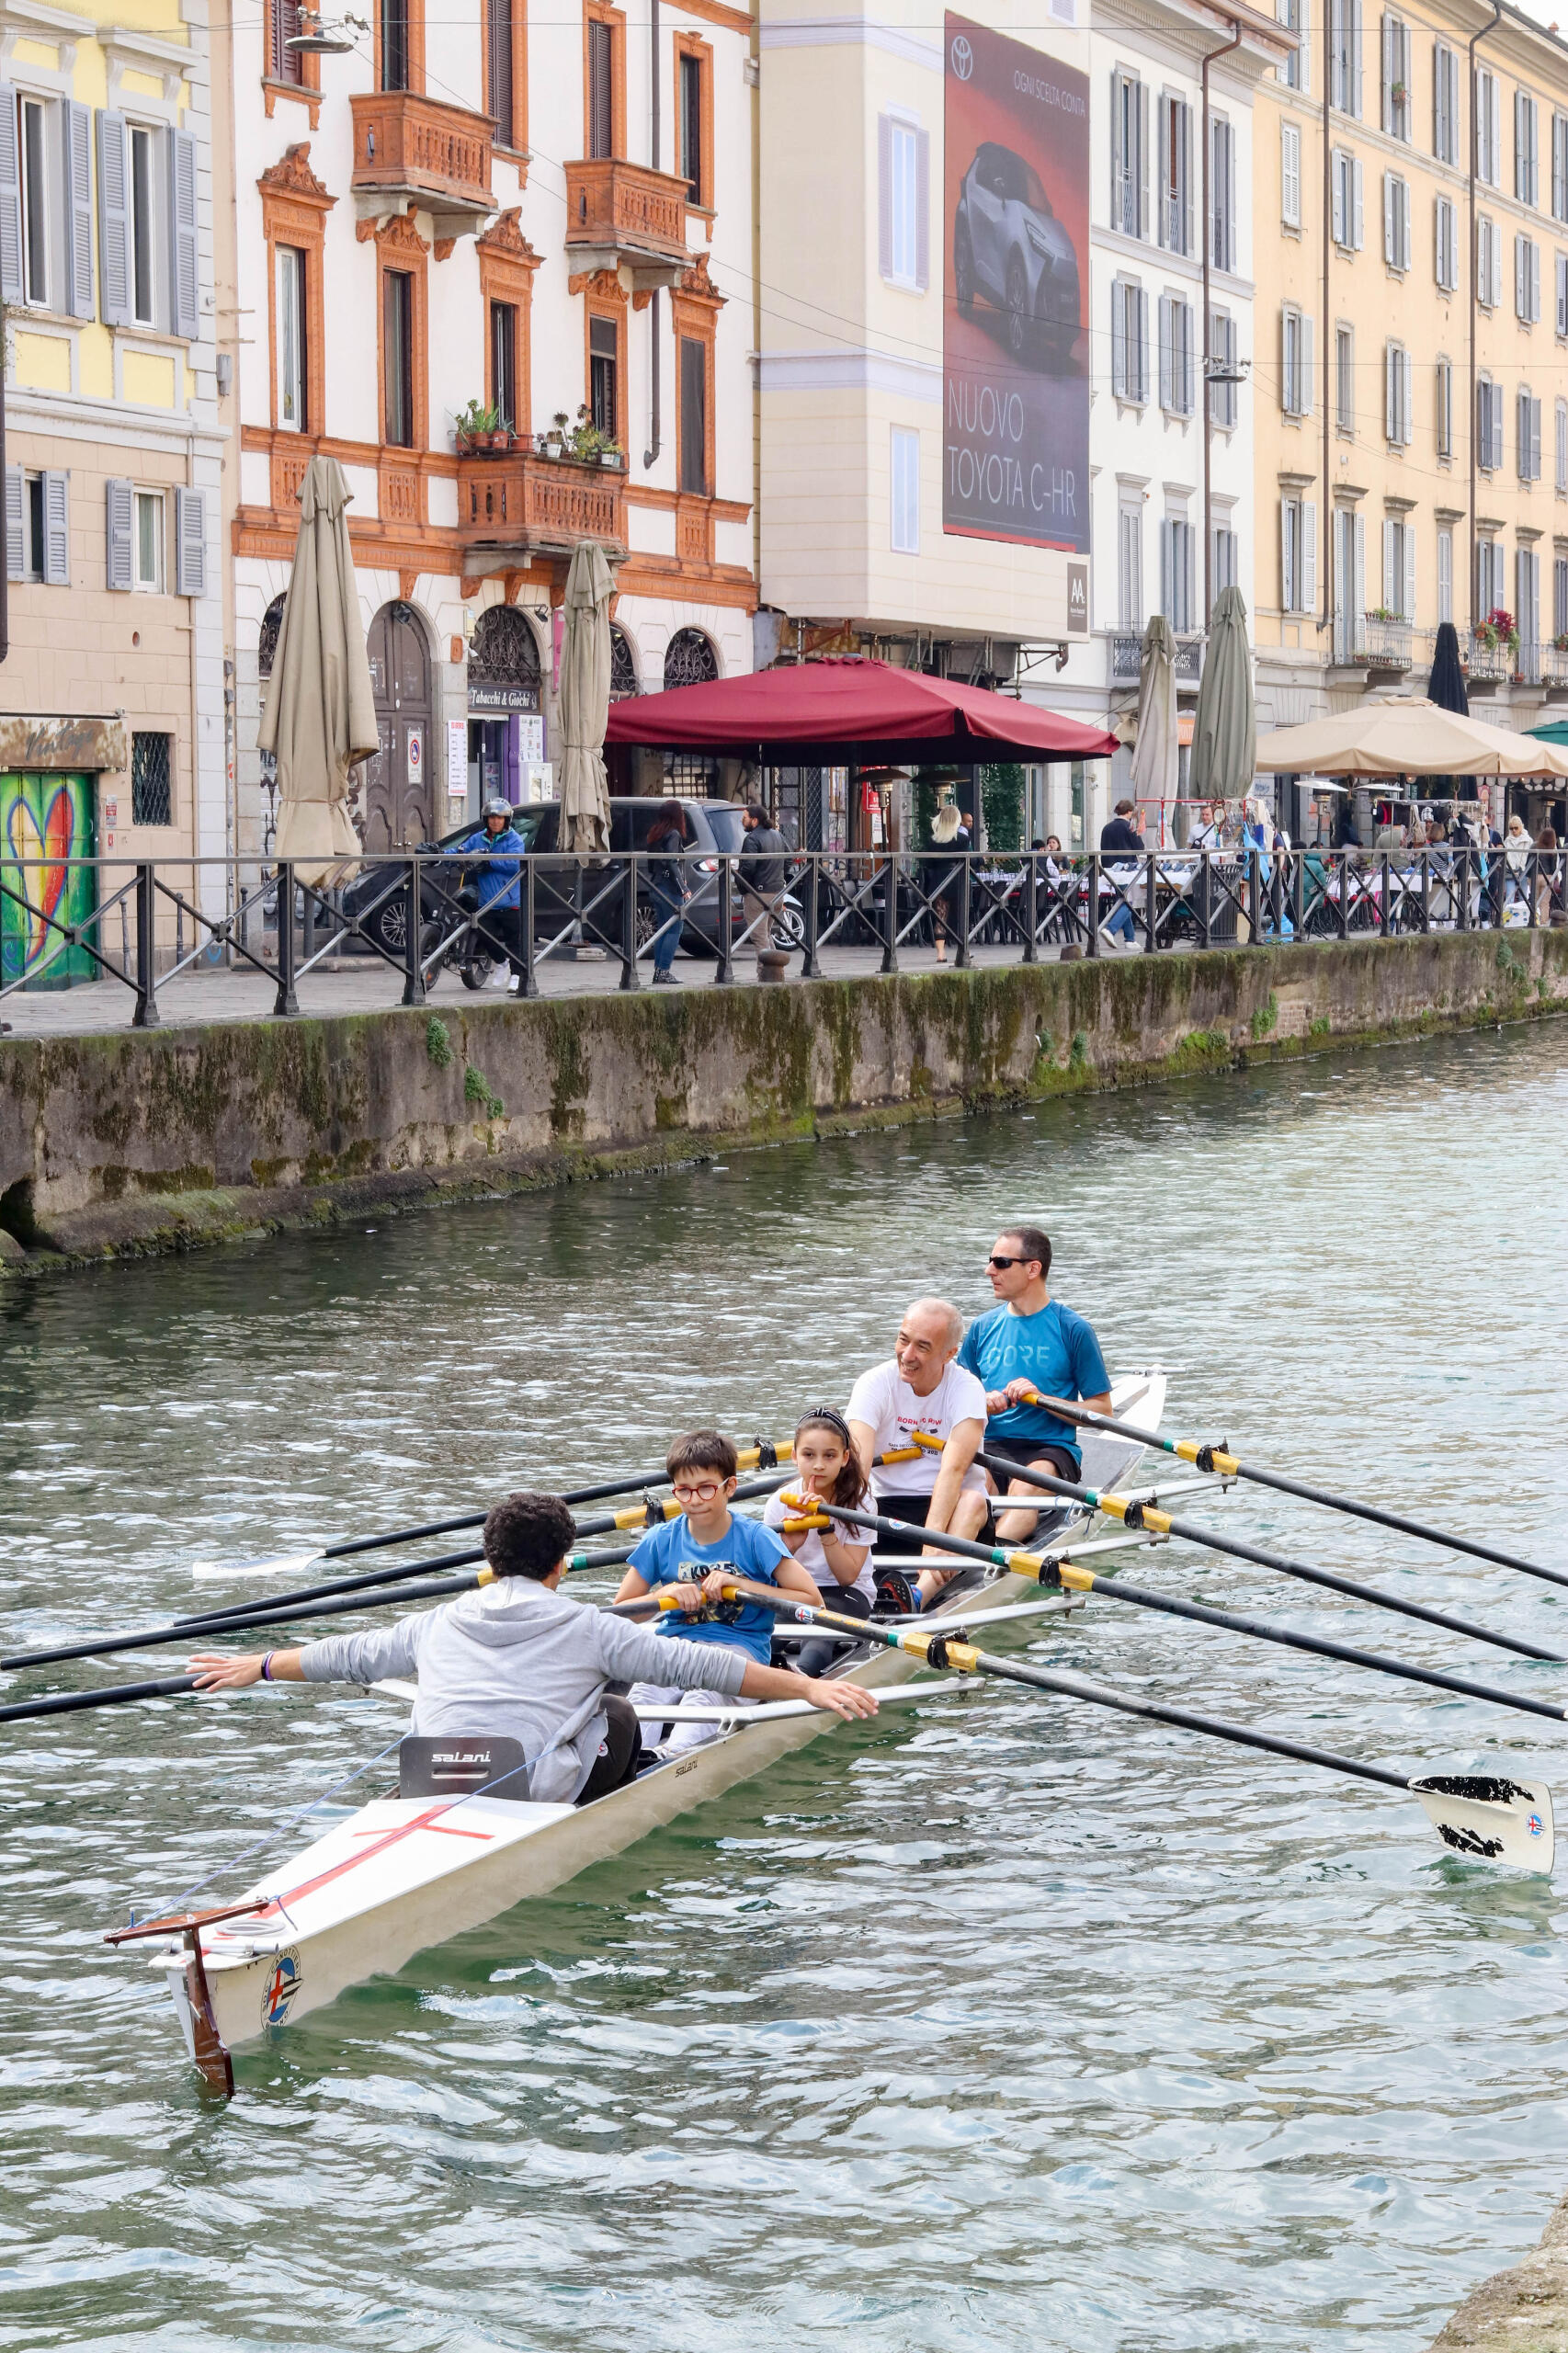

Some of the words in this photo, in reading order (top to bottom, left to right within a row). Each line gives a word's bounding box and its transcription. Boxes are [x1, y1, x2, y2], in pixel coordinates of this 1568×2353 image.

[1015, 70, 1035, 97] OGNI
[1036, 79, 1061, 108] SCELTA
[1061, 90, 1085, 119] CONTA
[949, 379, 1024, 442] NUOVO
[948, 446, 1025, 508] TOYOTA
[1030, 462, 1077, 517] C-HR
[472, 689, 501, 706] Tabacchi
[501, 691, 507, 706] &
[508, 692, 529, 707] Giochi
[987, 1345, 1051, 1369] GORE
[897, 1416, 918, 1426] BORN
[431, 1751, 492, 1763] salani
